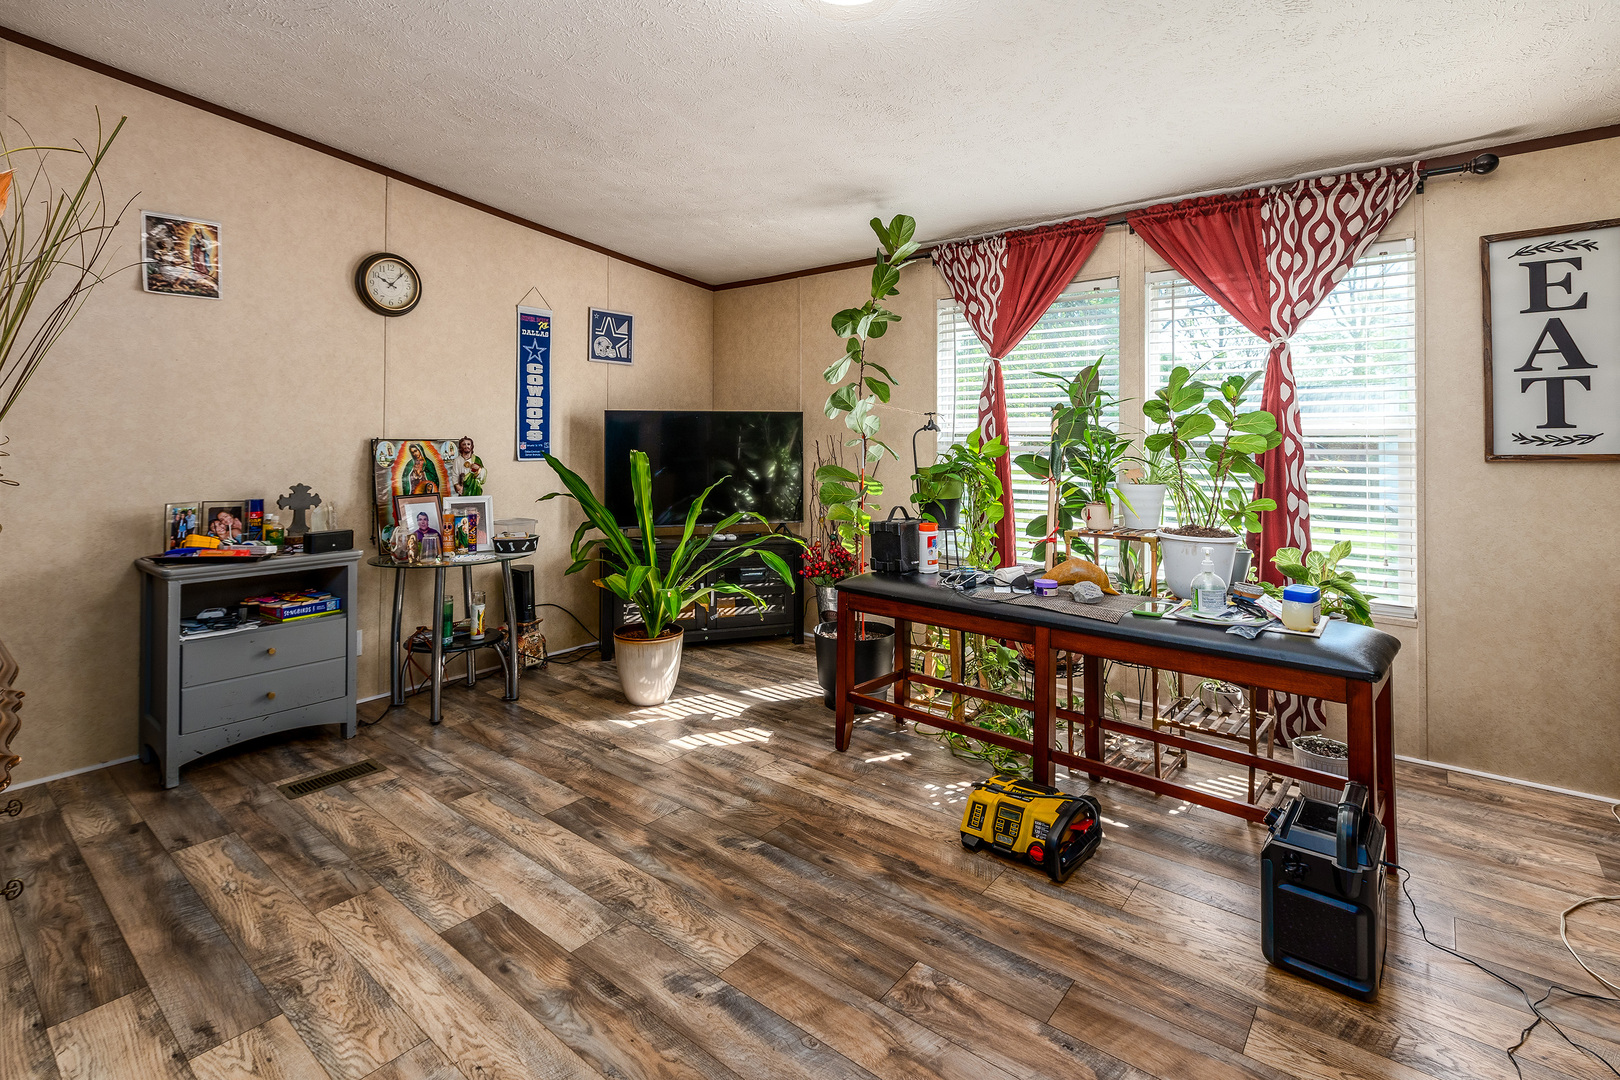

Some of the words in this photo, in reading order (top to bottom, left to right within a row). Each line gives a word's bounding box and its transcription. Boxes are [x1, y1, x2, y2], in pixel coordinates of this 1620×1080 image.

[521, 329, 549, 338] DALLAS
[1513, 256, 1598, 429] EAT
[526, 363, 544, 441] COWBOYS
